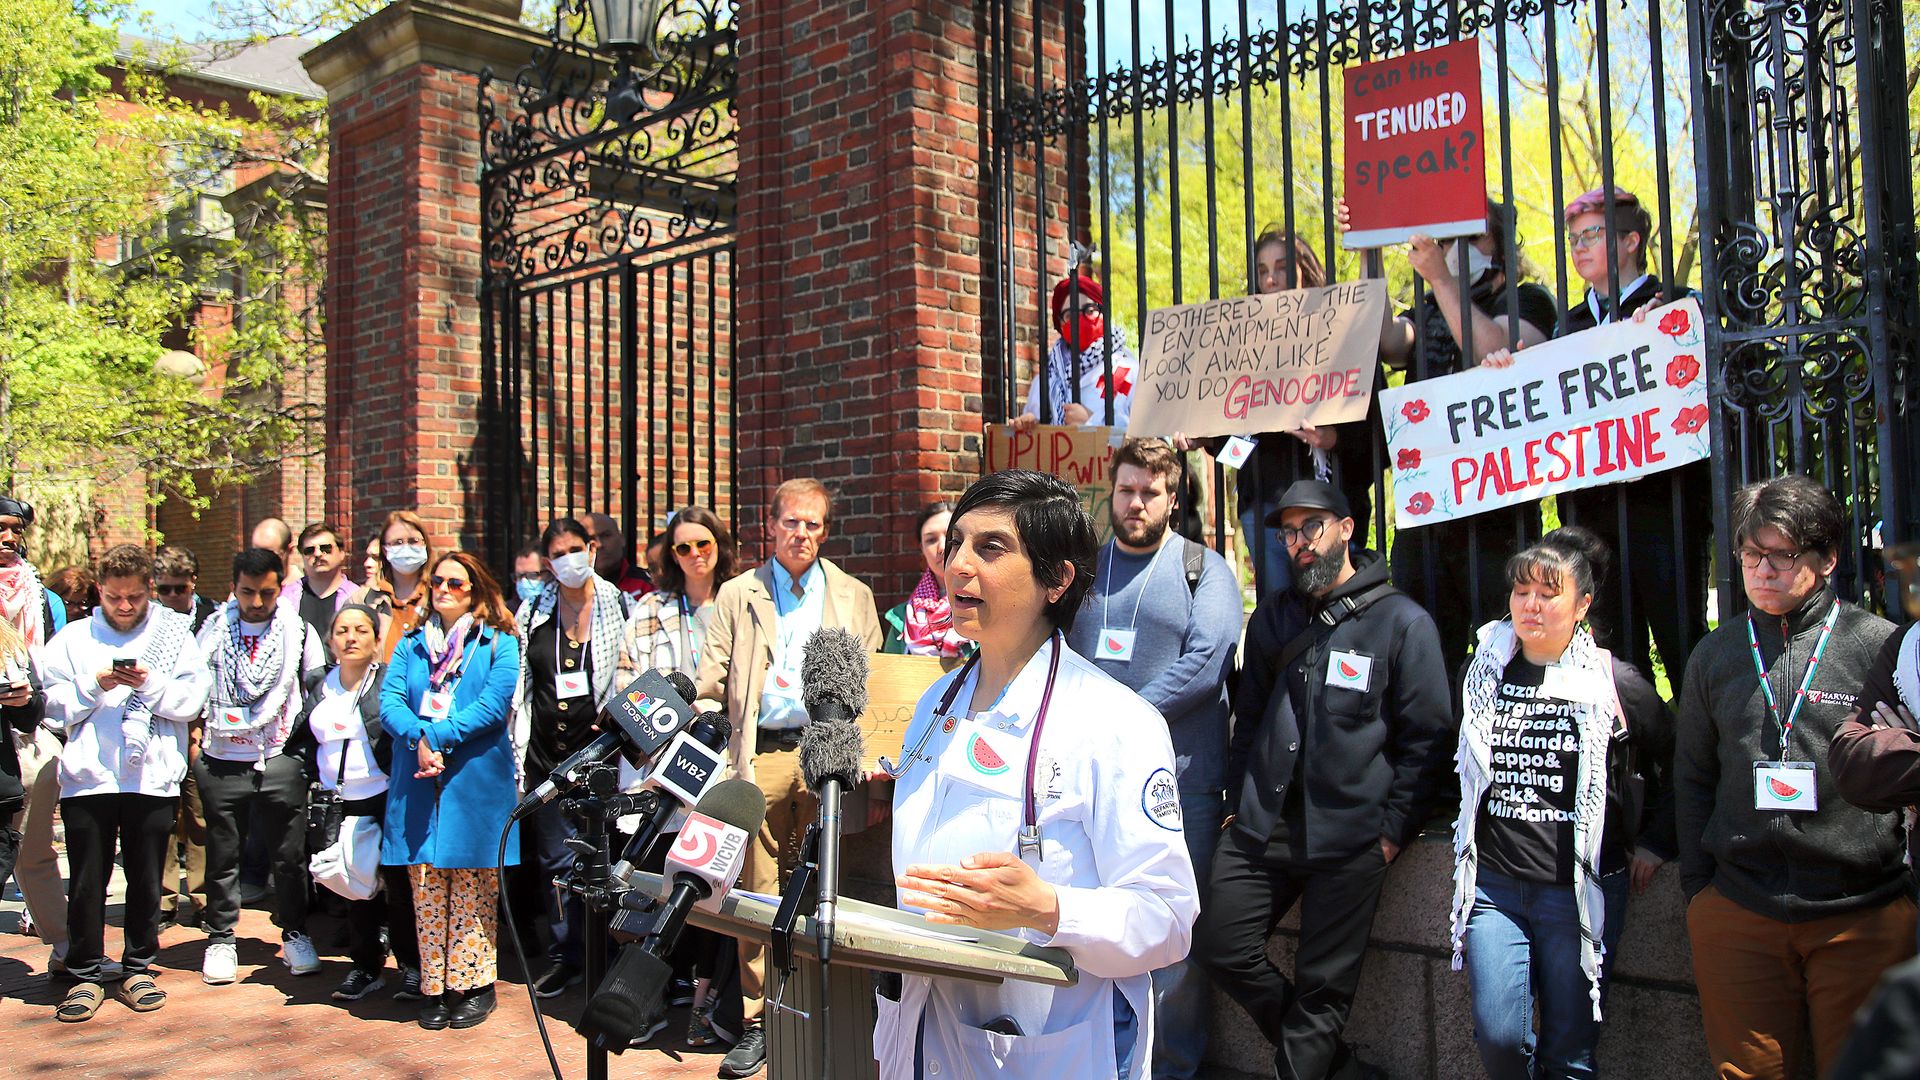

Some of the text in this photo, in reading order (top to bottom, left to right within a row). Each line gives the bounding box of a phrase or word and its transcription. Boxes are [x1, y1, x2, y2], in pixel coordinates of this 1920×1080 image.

[1353, 59, 1449, 97] Can the
[1354, 91, 1467, 142] TENURED
[1355, 131, 1477, 194] speak?
[1151, 283, 1369, 336] BOTHERED BY THE
[1143, 352, 1195, 382] LOOK
[1276, 336, 1331, 369] LIKE
[1156, 380, 1190, 403] YOU
[1198, 376, 1228, 400] DO
[1446, 345, 1658, 444] FREE FREE
[1451, 407, 1666, 505] PALESTINE
[647, 696, 680, 734] 10
[1496, 699, 1570, 718] erguson
[1821, 691, 1859, 702] HARVAR
[621, 701, 658, 741] BOSTON
[1491, 730, 1578, 751] akland&
[676, 754, 708, 782] WBZ
[710, 832, 742, 873] WCVB
